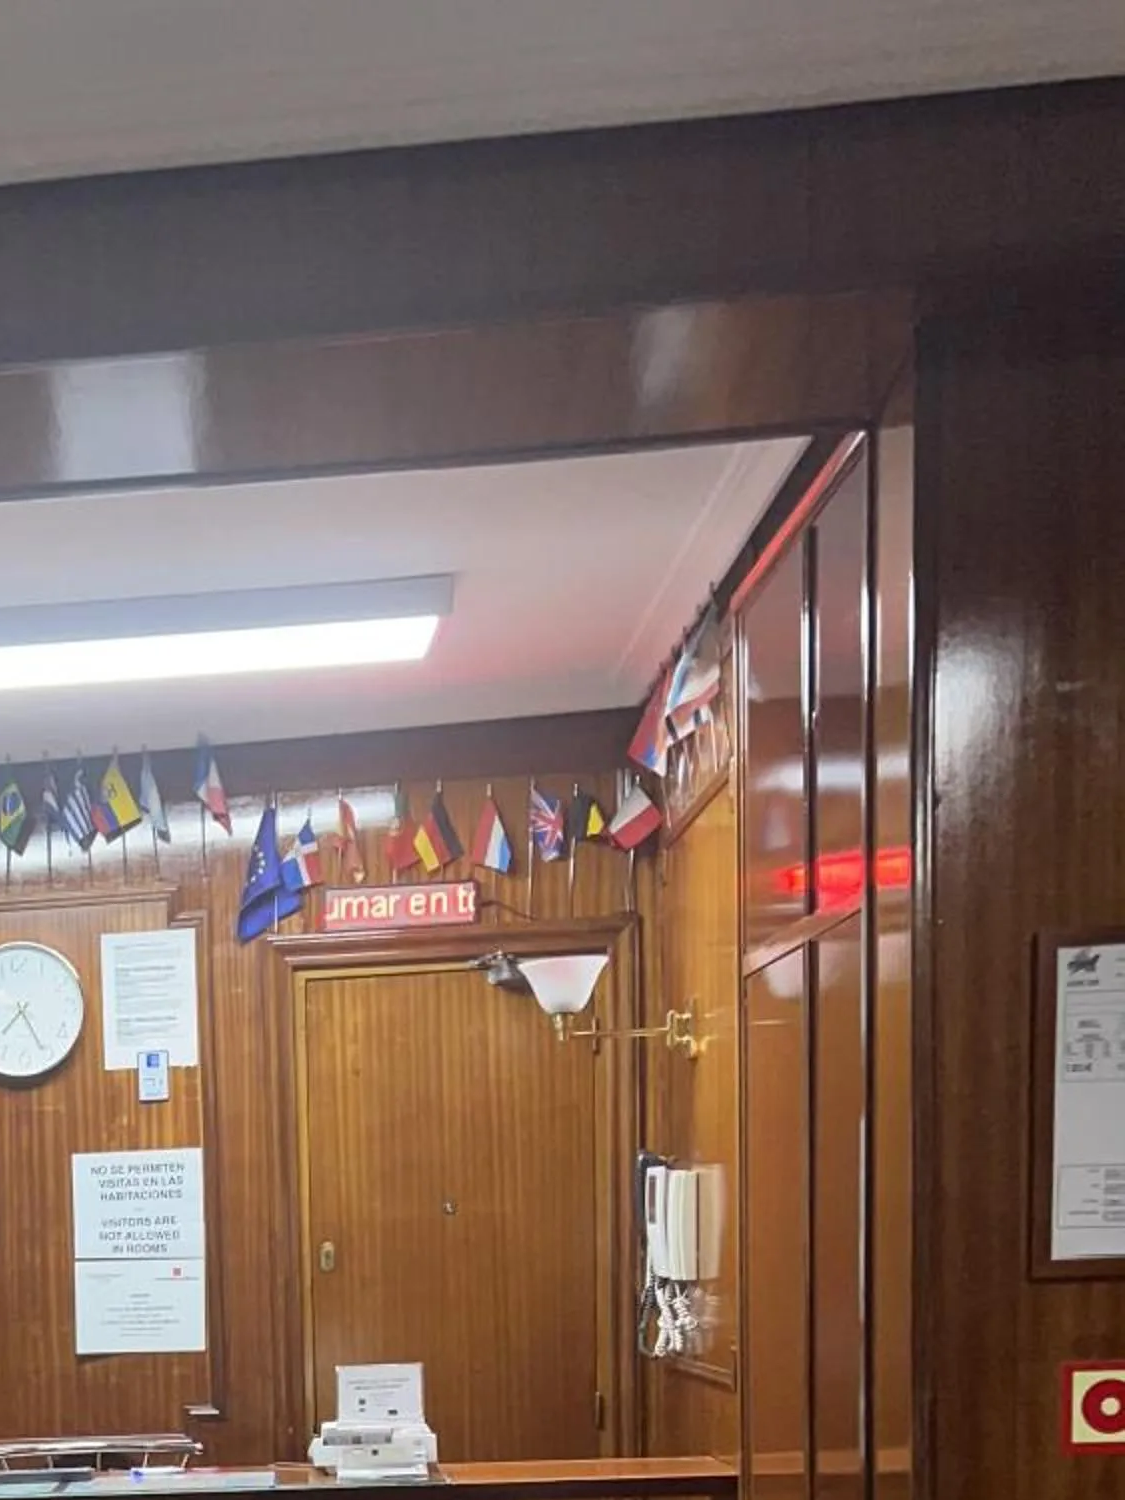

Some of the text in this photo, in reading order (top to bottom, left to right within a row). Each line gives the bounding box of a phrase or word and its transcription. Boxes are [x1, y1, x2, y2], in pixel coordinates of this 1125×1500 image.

[409, 891, 448, 917] en
[91, 1163, 185, 1176] NO SE PERMITEN
[99, 1176, 184, 1189] VISITAS EN LAS
[101, 1190, 183, 1201] HABITACIONES
[101, 1216, 178, 1228] VISITORS ARE
[99, 1230, 181, 1241] NOT ALLOWED
[113, 1243, 168, 1254] IN ROOMS
